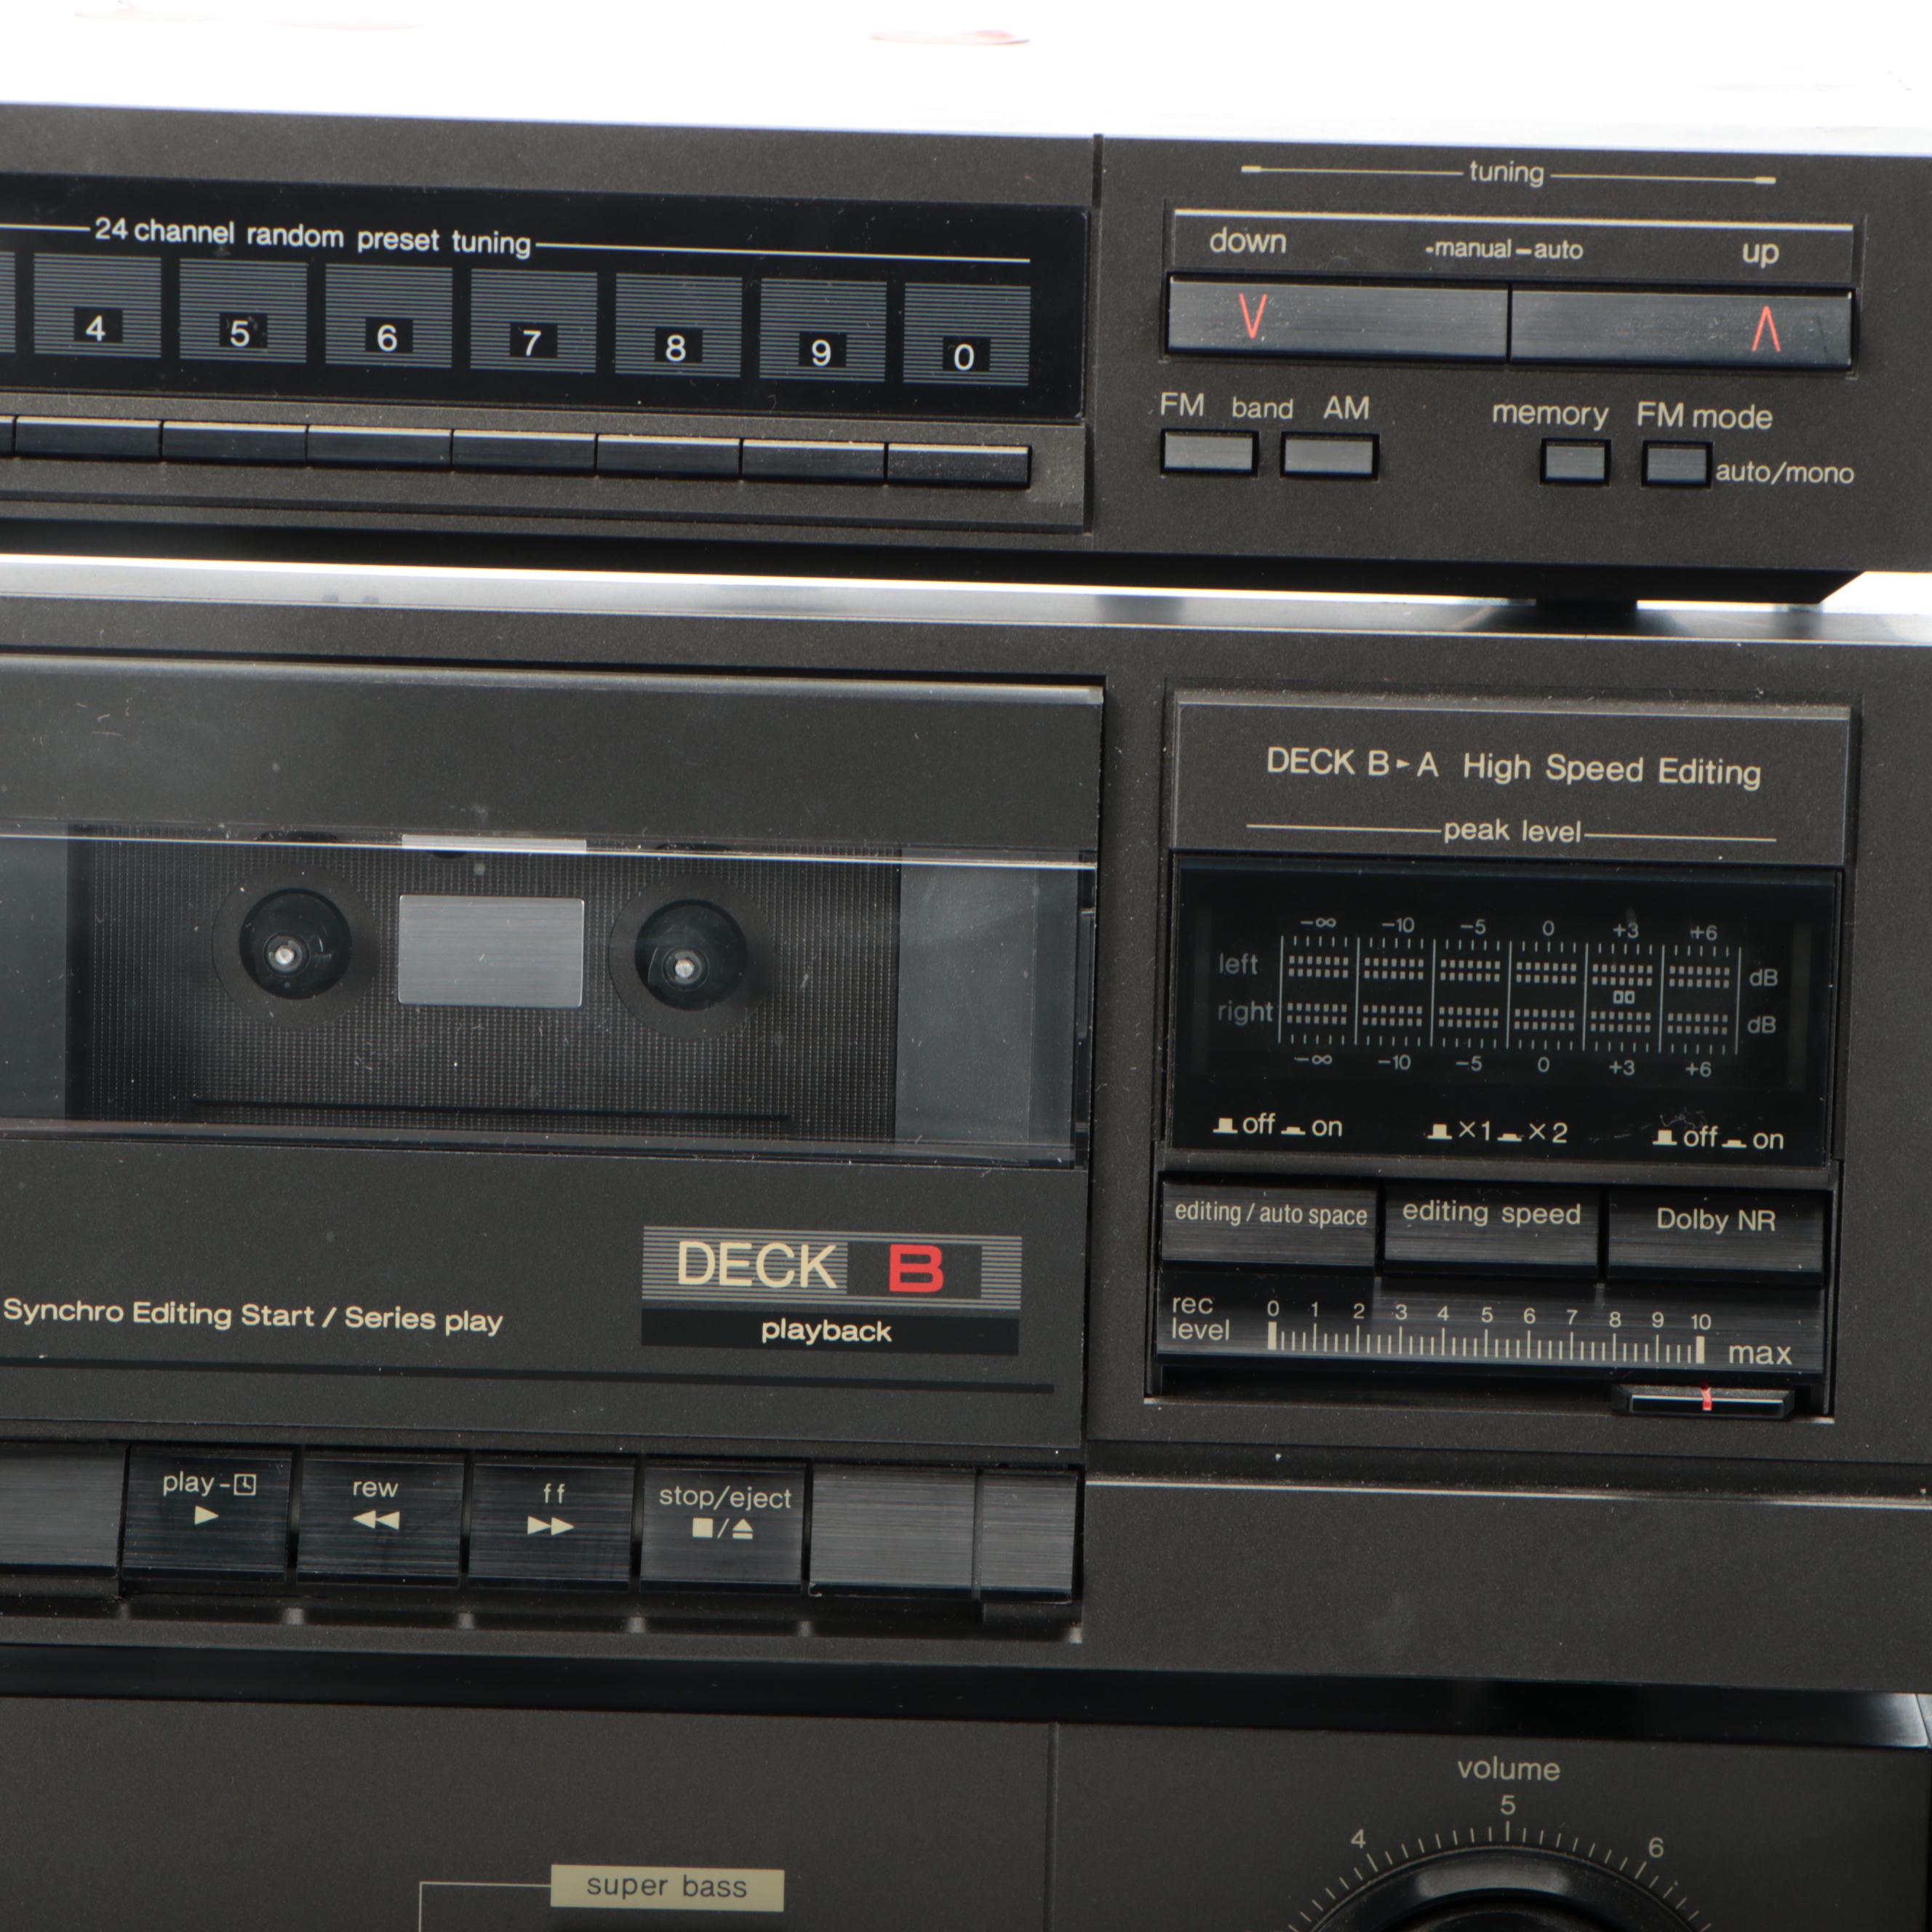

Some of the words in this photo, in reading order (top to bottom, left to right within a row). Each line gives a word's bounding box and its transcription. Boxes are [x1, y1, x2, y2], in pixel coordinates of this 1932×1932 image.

[1469, 158, 1545, 188] tuning
[95, 215, 127, 242] 24
[135, 219, 234, 244] channel
[247, 223, 344, 249] random
[356, 228, 439, 253] preset
[452, 230, 532, 259] tuning
[1210, 226, 1287, 254] down
[1742, 241, 1779, 268] up
[85, 315, 106, 343] 4
[229, 320, 250, 348] 5
[376, 324, 398, 352] 6
[522, 330, 542, 357] 7
[665, 334, 687, 362] 8
[811, 338, 832, 367] 9
[954, 343, 975, 371] 0
[1160, 392, 1204, 417] FM
[1232, 396, 1293, 419] band
[1323, 396, 1370, 421] AM
[1493, 403, 1609, 431] memory
[1637, 402, 1684, 428] FM
[1693, 404, 1773, 429] mode
[1716, 460, 1854, 485] auto/mono
[1267, 746, 1354, 775] DECK
[1368, 750, 1389, 776] B
[1417, 751, 1439, 778] A
[1464, 753, 1530, 785] High
[1546, 753, 1644, 785] Speed
[1658, 757, 1762, 792] Editing
[1444, 818, 1510, 843] peak
[1522, 819, 1581, 844] level
[1382, 917, 1414, 933] -10
[1460, 919, 1486, 935] -5
[1542, 921, 1554, 936] 0
[1613, 922, 1639, 938] +3
[1690, 925, 1718, 941] +6
[1219, 952, 1258, 975] left
[1749, 968, 1779, 987] dB
[1218, 1000, 1274, 1026] right
[1747, 1016, 1777, 1034] dB
[1378, 1054, 1411, 1069] -10
[1456, 1056, 1482, 1071] -5
[1537, 1057, 1550, 1072] 0
[1609, 1060, 1635, 1076] +3
[1685, 1061, 1712, 1077] +6
[1242, 1112, 1275, 1135] off
[1312, 1119, 1343, 1137] on
[1683, 1125, 1717, 1147] off
[1752, 1131, 1784, 1150] on
[1175, 1201, 1242, 1226] editing
[1259, 1204, 1303, 1224] auto
[1309, 1208, 1368, 1230] space
[1402, 1199, 1488, 1226] editing
[1501, 1204, 1581, 1227] speed
[1657, 1208, 1729, 1234] Dolby
[1739, 1210, 1776, 1232] NR
[678, 1240, 837, 1290] DECK
[889, 1243, 944, 1293] B
[2, 1298, 124, 1325] Synchro
[133, 1301, 232, 1330] Editing
[241, 1304, 315, 1327] Start
[345, 1306, 436, 1330] Series
[444, 1309, 504, 1336] play
[1173, 1297, 1213, 1314] rec
[1268, 1299, 1280, 1317] 0
[1312, 1301, 1319, 1317] 1
[1353, 1303, 1365, 1319] 2
[1395, 1304, 1408, 1320] 3
[1437, 1305, 1449, 1322] 4
[1480, 1306, 1493, 1322] 5
[1523, 1308, 1536, 1325] 6
[1567, 1309, 1577, 1325] 7
[1609, 1312, 1621, 1328] 8
[1652, 1312, 1664, 1329] 9
[1691, 1314, 1711, 1330] 10
[762, 1319, 892, 1345] playback
[1172, 1319, 1229, 1340] level
[1730, 1346, 1792, 1364] max
[353, 1479, 399, 1498] rew
[659, 1487, 792, 1512] stop/eject
[1458, 1755, 1560, 1781] volume
[1501, 1795, 1516, 1816] 5
[1351, 1829, 1366, 1850] 4
[1648, 1837, 1664, 1859] 6
[586, 1876, 668, 1899] super
[683, 1875, 747, 1898] bass
